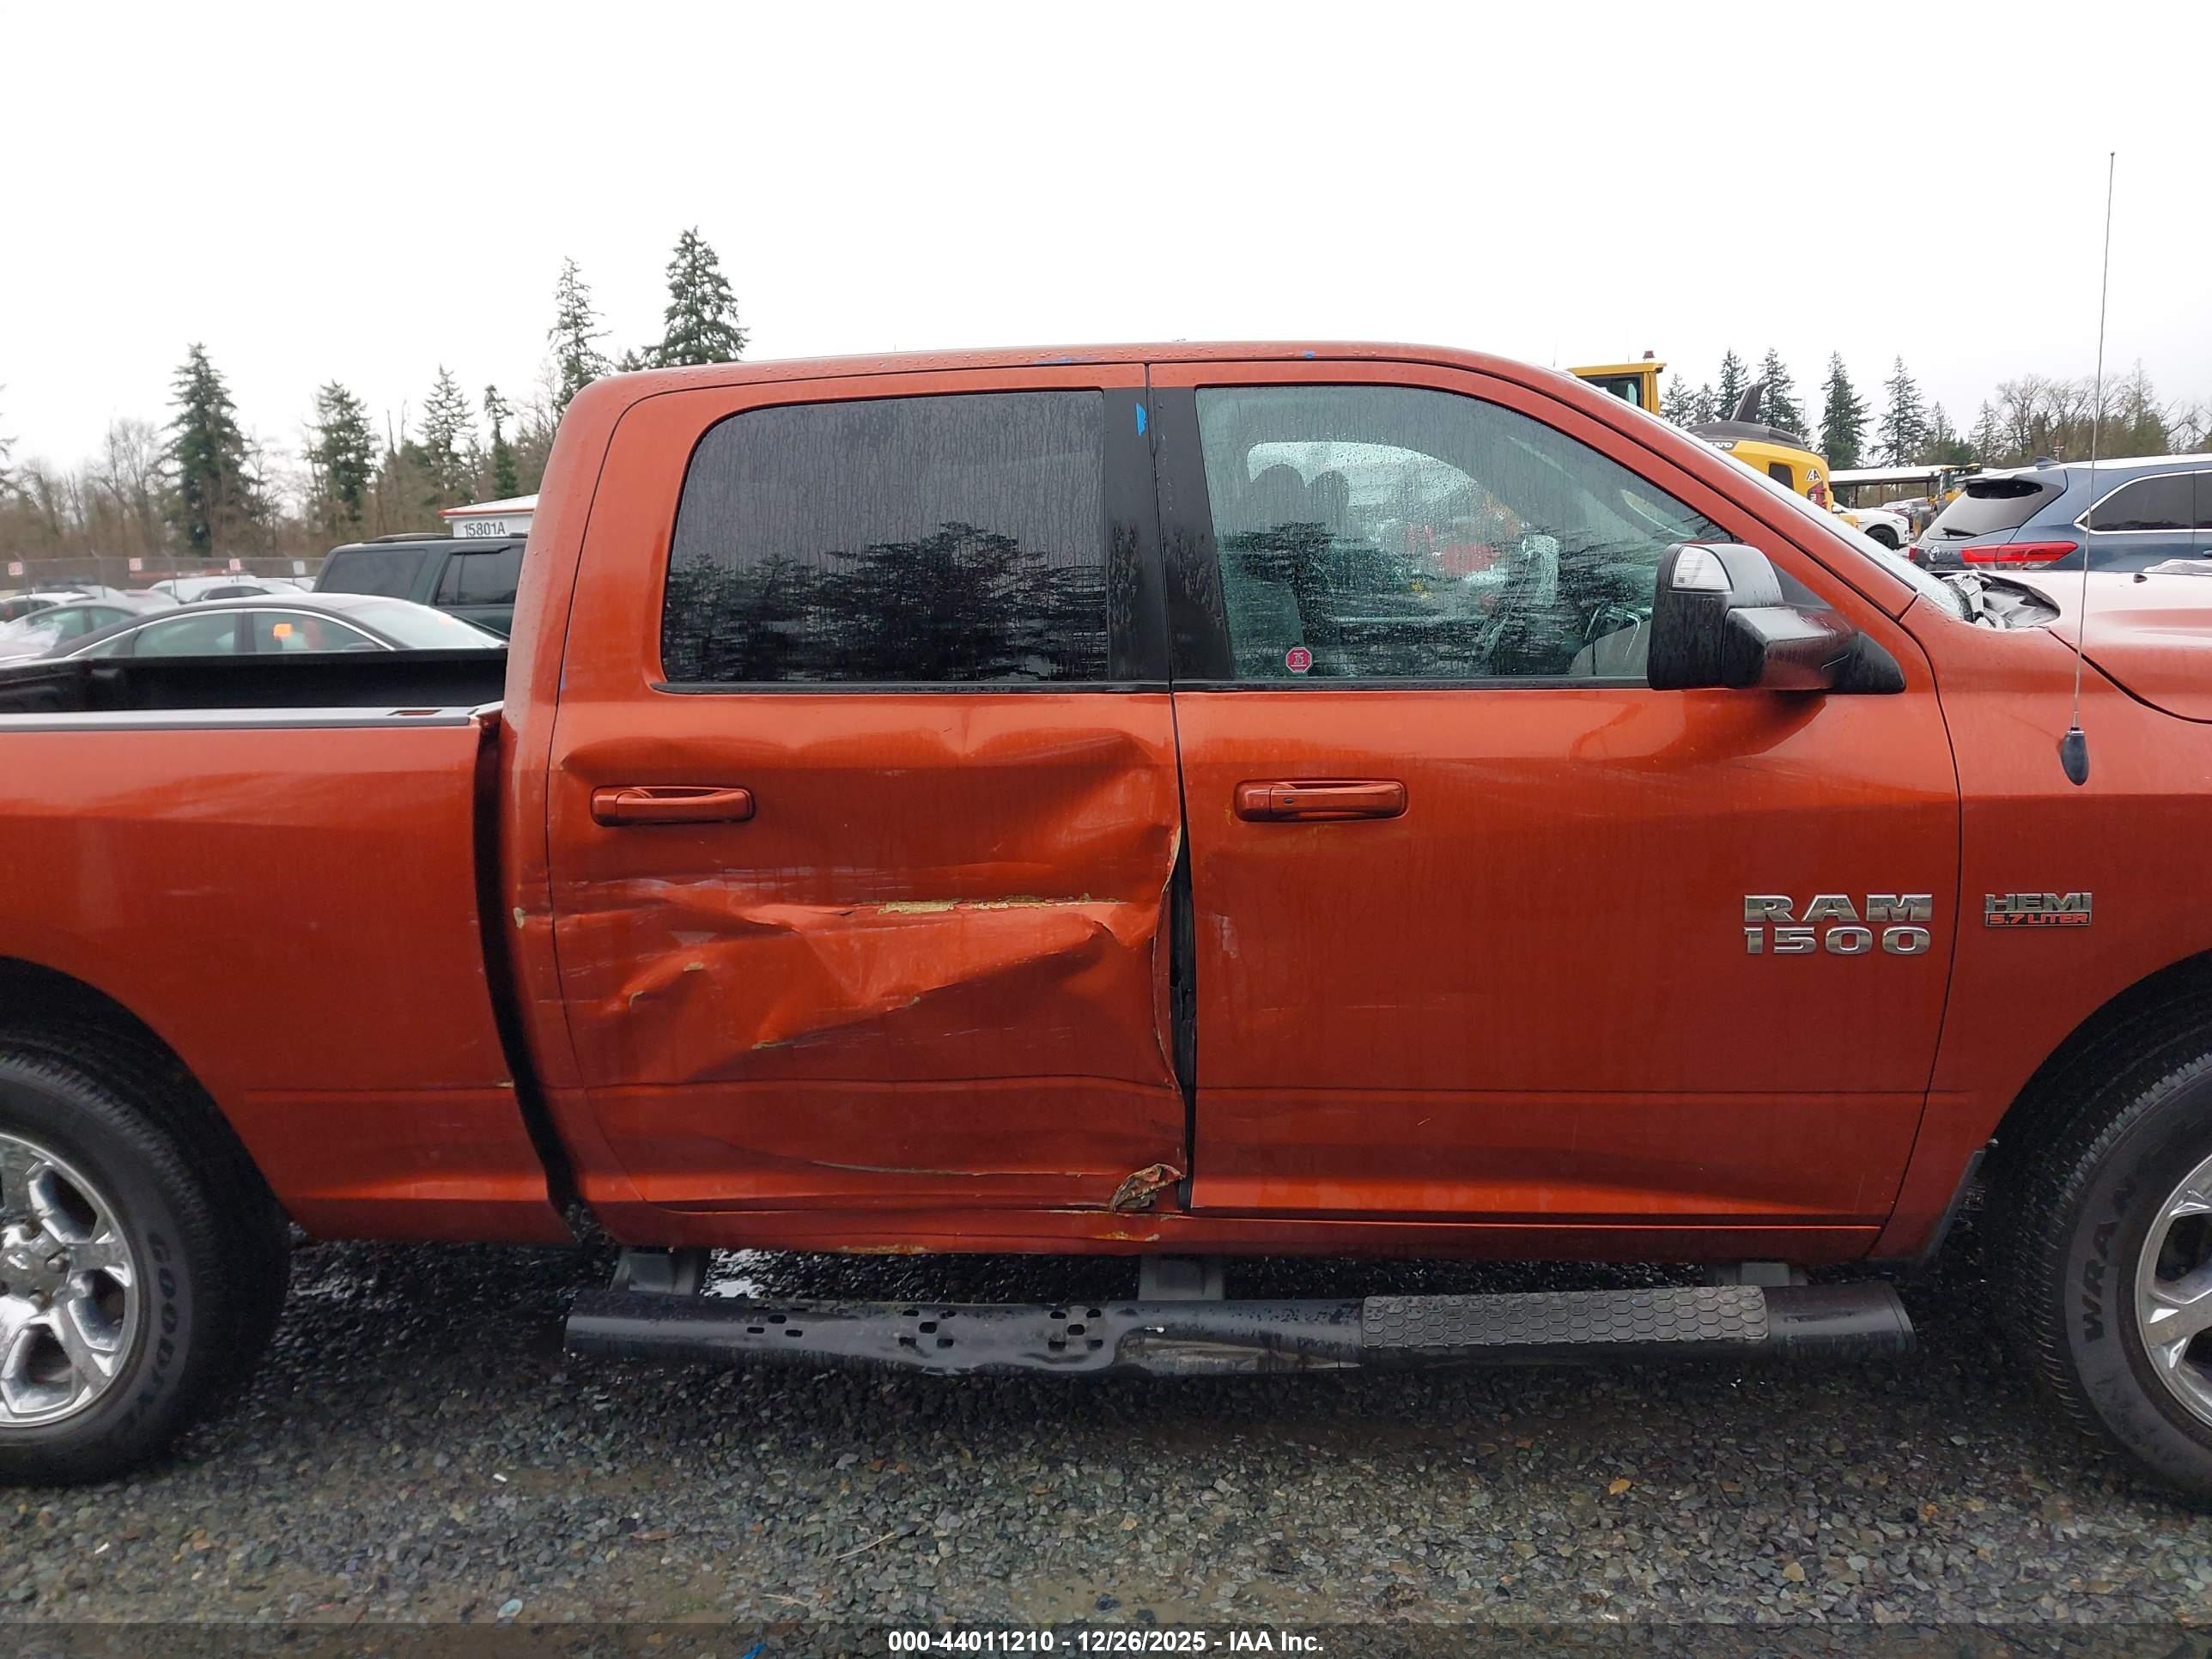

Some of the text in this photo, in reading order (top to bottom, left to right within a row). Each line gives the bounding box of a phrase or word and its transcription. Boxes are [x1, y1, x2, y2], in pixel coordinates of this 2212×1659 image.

[464, 521, 507, 537] 15801A
[1743, 893, 1933, 923] RAM
[1984, 892, 2093, 912] HEMI
[1989, 913, 2088, 924] 5.7 LITER
[1743, 926, 1932, 955] 1500
